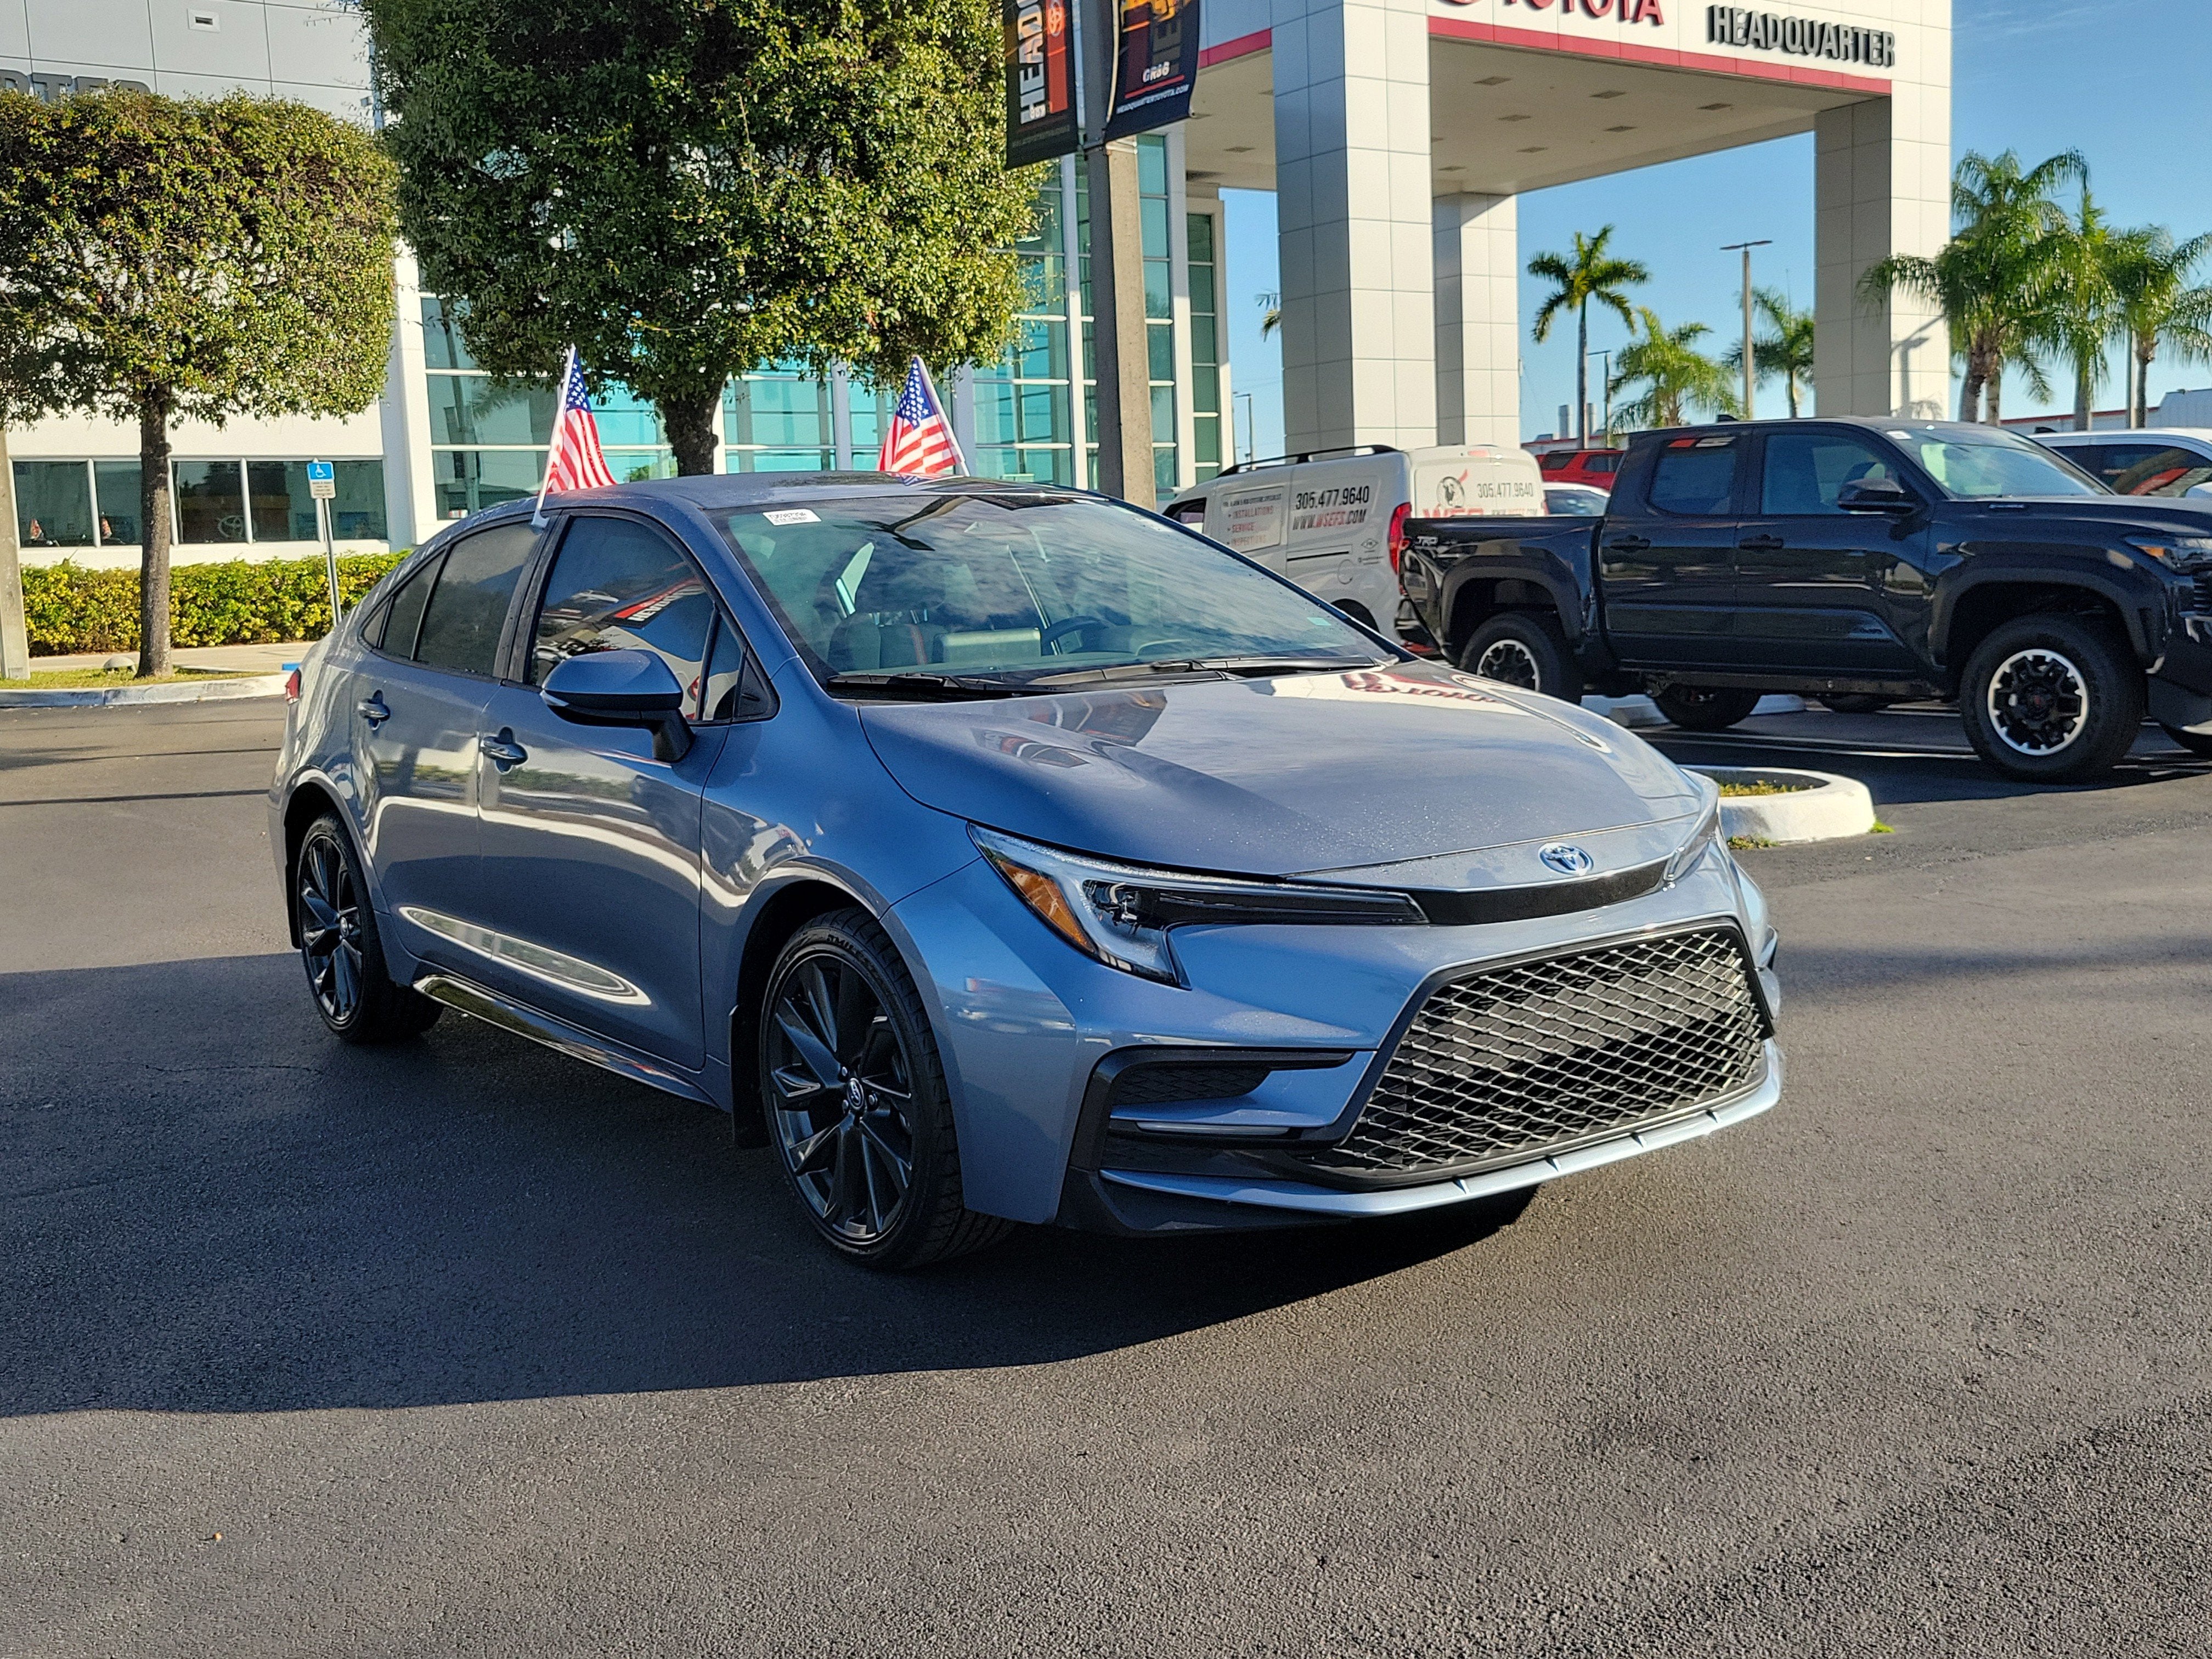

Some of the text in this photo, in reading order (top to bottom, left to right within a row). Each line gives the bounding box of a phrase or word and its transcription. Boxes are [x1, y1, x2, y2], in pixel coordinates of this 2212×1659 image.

[1706, 4, 1895, 67] HEADQUARTER
[1017, 0, 1046, 124] HEAD
[1295, 485, 1370, 510] 305.477.9640
[1477, 482, 1533, 498] 305.477.9640
